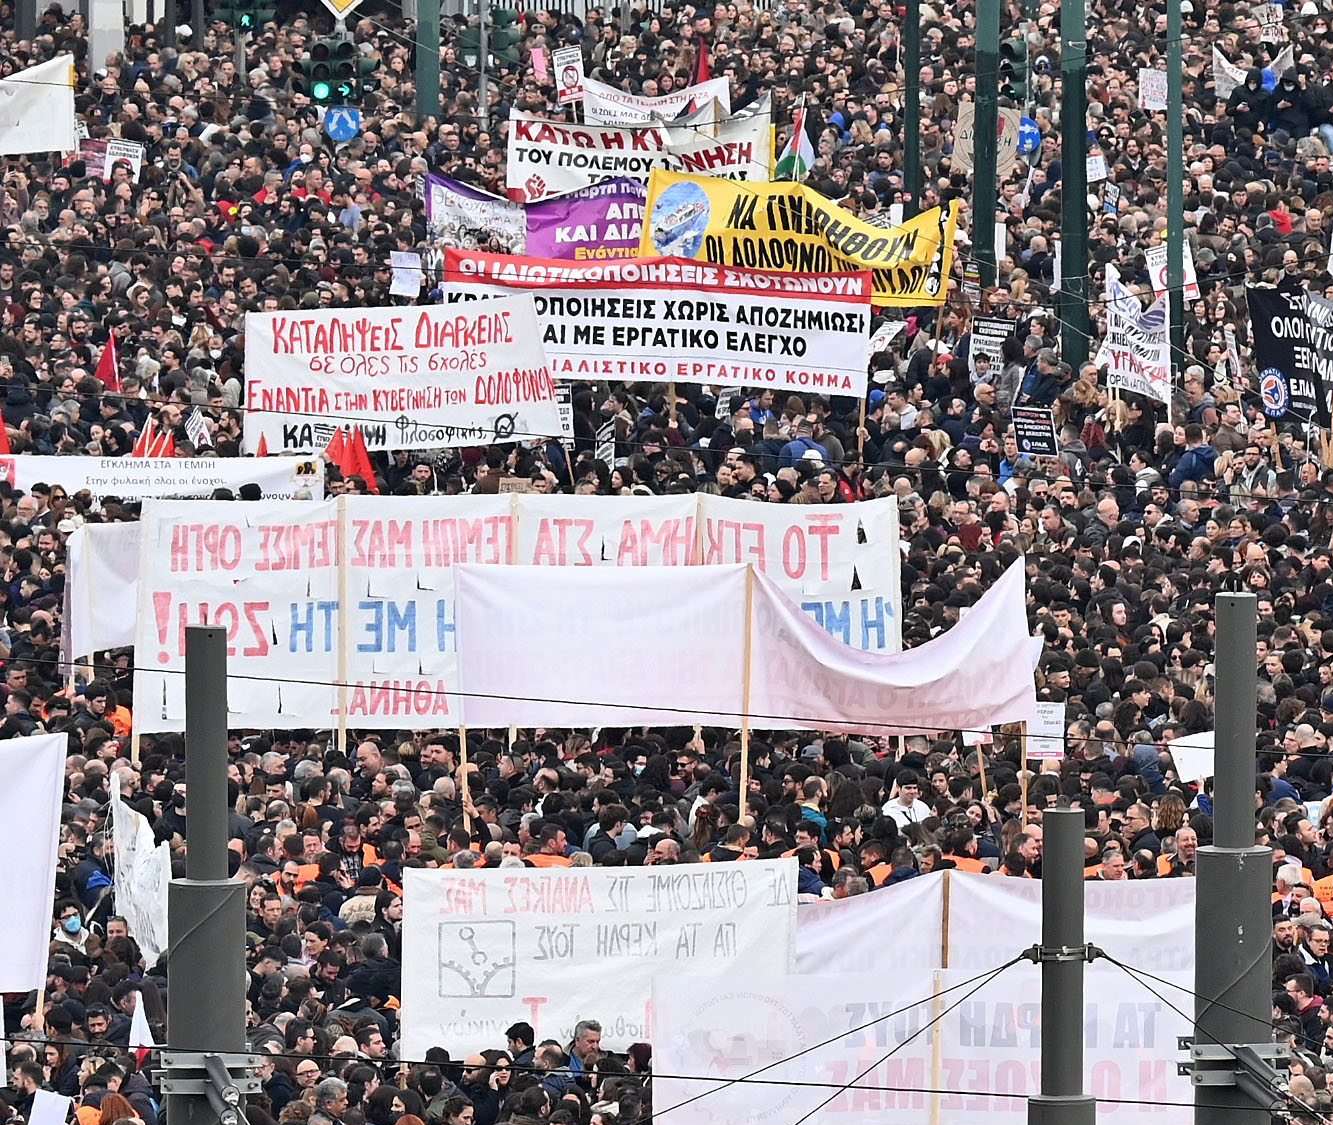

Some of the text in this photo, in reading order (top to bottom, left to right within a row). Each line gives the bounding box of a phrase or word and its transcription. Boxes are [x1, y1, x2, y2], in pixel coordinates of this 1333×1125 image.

[515, 119, 624, 149] ΚΑΤΩ Η
[515, 147, 551, 165] ΤΟΥ
[558, 151, 654, 172] ΠΟΛΕΜΟΥ
[725, 192, 759, 230] ΝΑ
[555, 224, 597, 243] ΚΑΙ
[458, 258, 863, 297] ΟΙ ΙΔΙΩΤΙΚΟΠΟΙΗΣΕΙΣ ΣΚΟΤΩΝΟΥΝ
[664, 300, 730, 323] ΧΩΡΙΣ
[414, 311, 513, 349] ΔΙΑΡΚΕΙΑΣ
[573, 326, 808, 357] ΜΕ ΕΡΓΑΤΙΚΟ ΕΛΕΓΧΟ
[247, 379, 330, 413] ΕΝΑΝΤΙΑ
[372, 384, 443, 412] ΚΥΒΕΡΝΗΣΗ
[474, 366, 556, 405] ΔΟΛΟΦΟΝΩΝ
[676, 363, 852, 390] ΕΡΓΑΤΙΚΟ ΚΟΜΜΑ
[100, 460, 216, 470] ΕΓΚΛΗΜΑ ΣΤΑ ΤΕΜΠΗ
[85, 477, 109, 487] Στην
[111, 475, 152, 488] φυλακή
